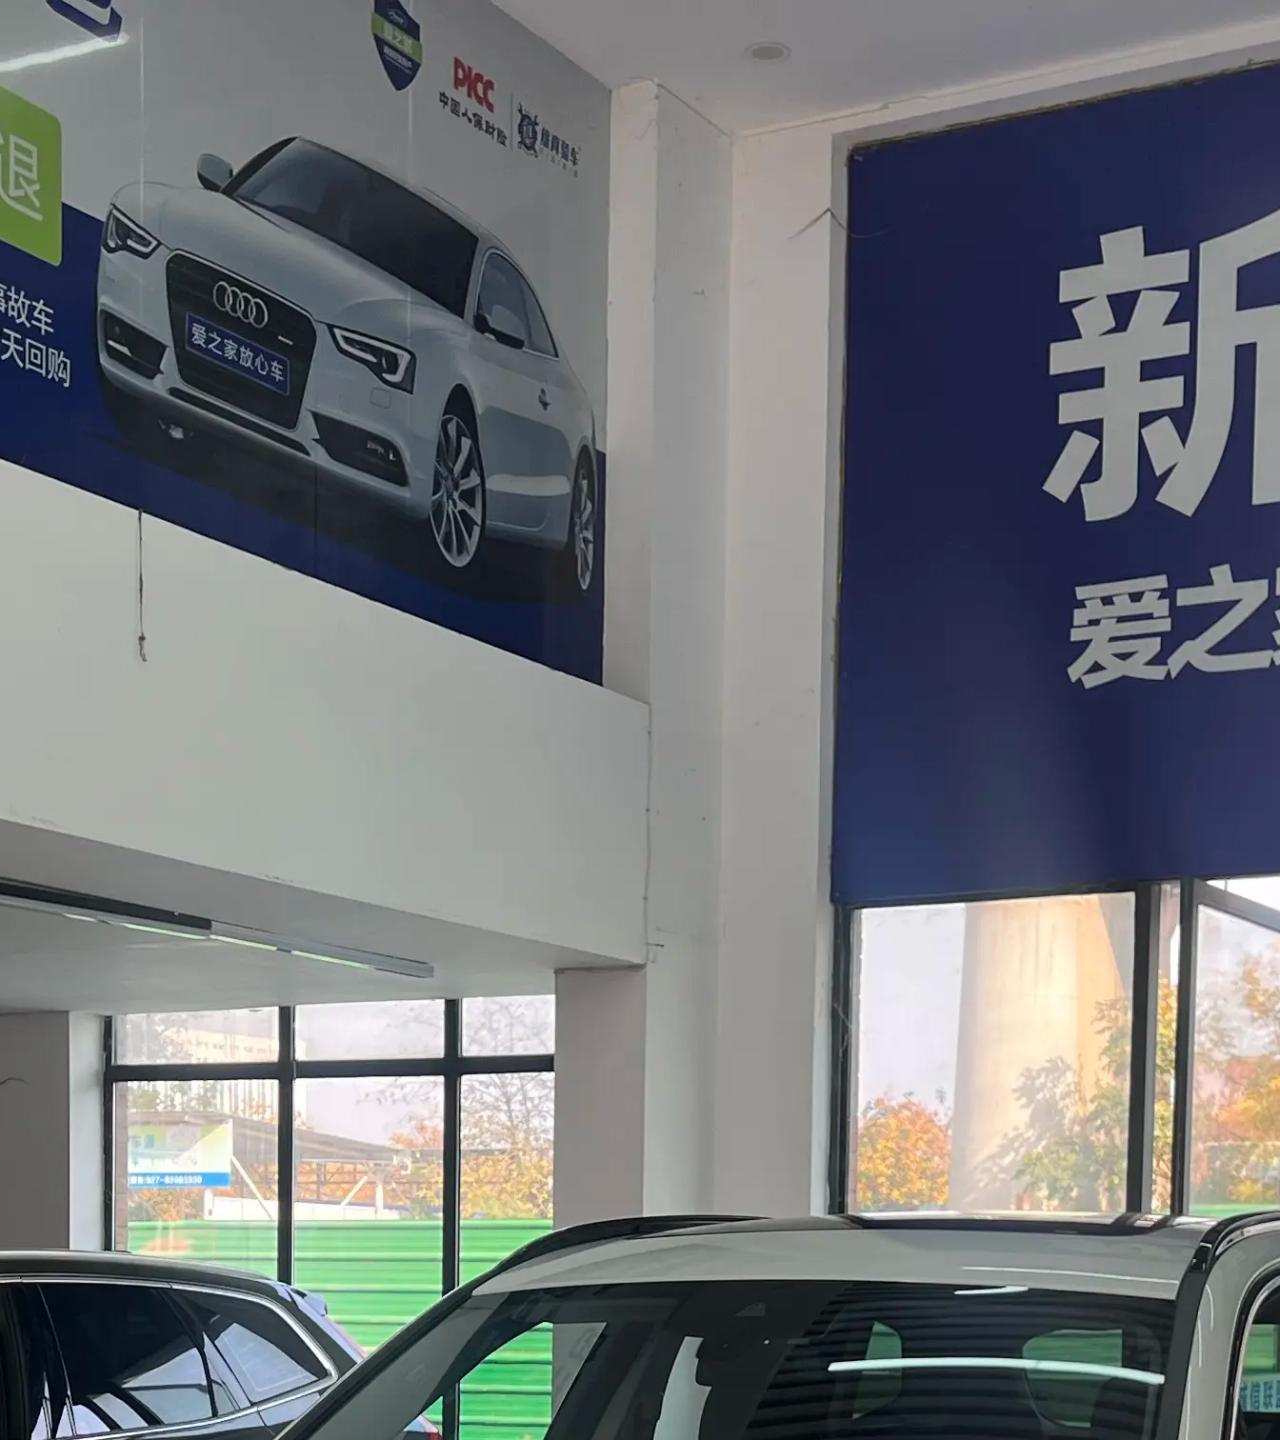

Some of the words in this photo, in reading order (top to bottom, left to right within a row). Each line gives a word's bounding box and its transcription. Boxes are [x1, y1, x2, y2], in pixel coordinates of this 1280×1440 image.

[453, 56, 495, 113] PICC
[191, 322, 285, 383] 爱之家放心车
